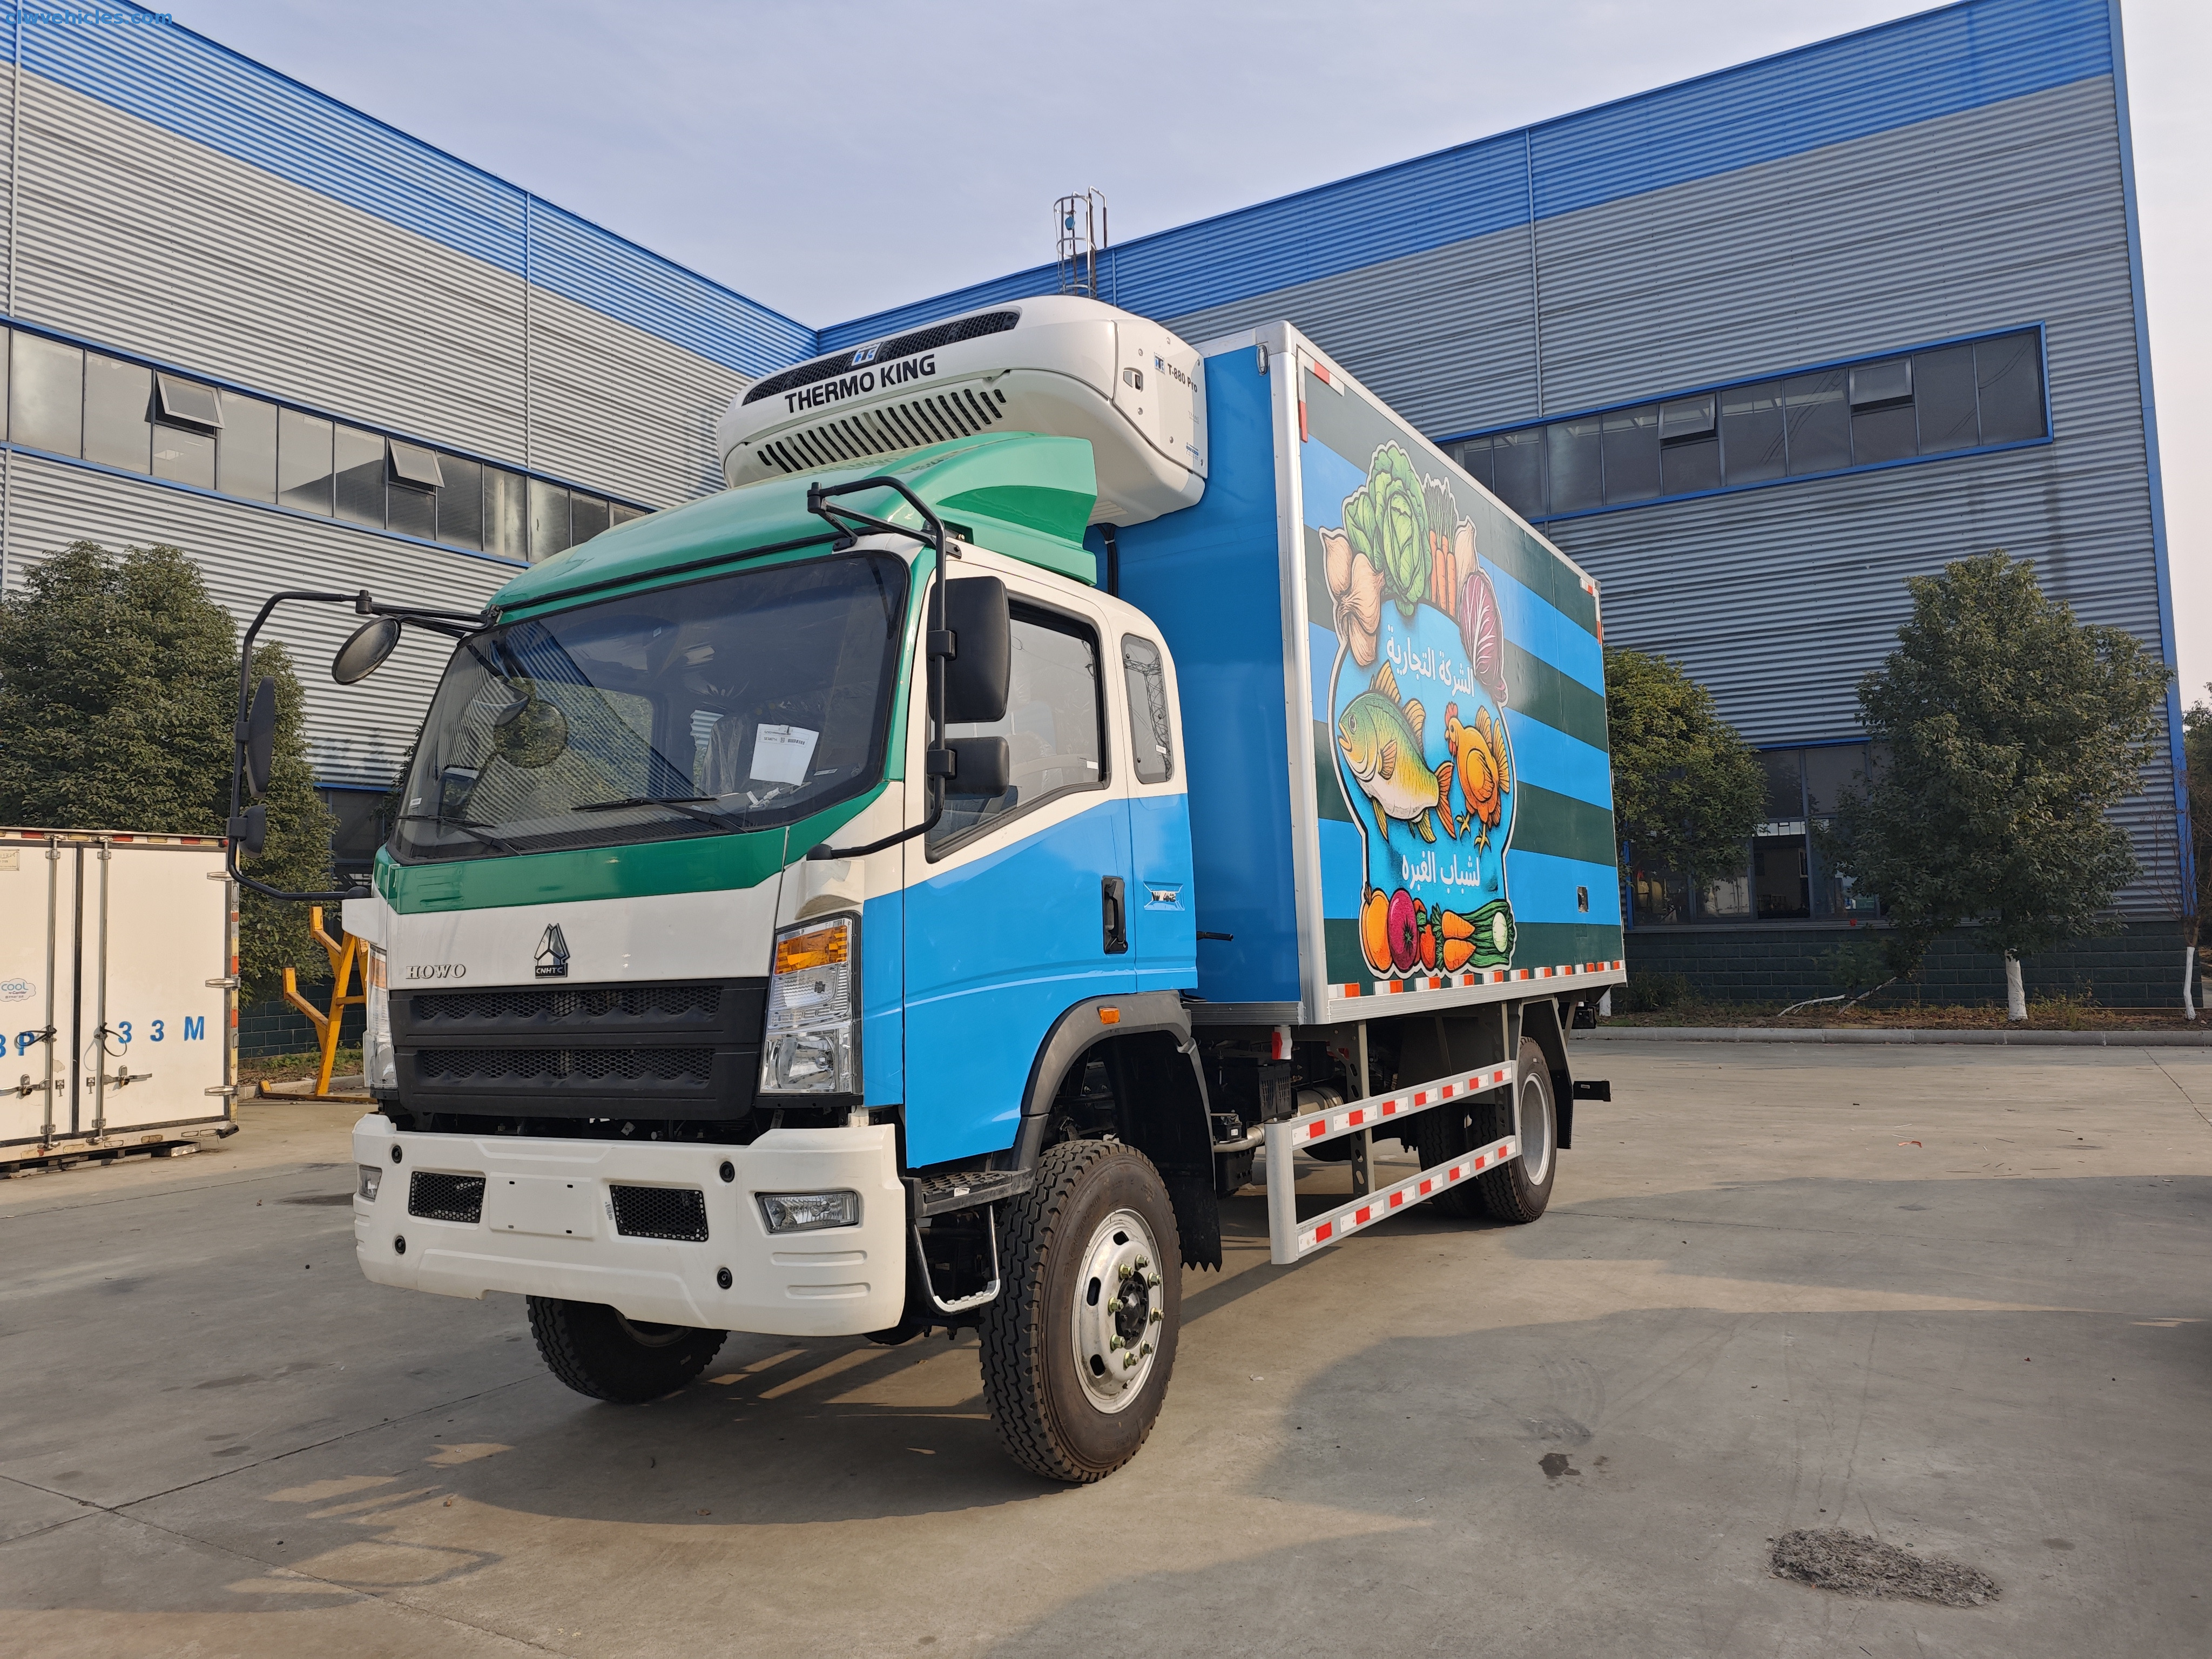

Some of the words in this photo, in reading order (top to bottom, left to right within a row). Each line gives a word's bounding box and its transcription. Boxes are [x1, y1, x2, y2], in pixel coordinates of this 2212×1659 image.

[785, 372, 875, 413] THERMO
[880, 354, 936, 388] KING
[1167, 362, 1186, 385] T-880
[1187, 376, 1198, 393] Pro
[1386, 624, 1437, 681] التجارية
[1439, 650, 1475, 698] الشركة
[1440, 853, 1480, 894] لشباب
[405, 963, 466, 979] HOWO
